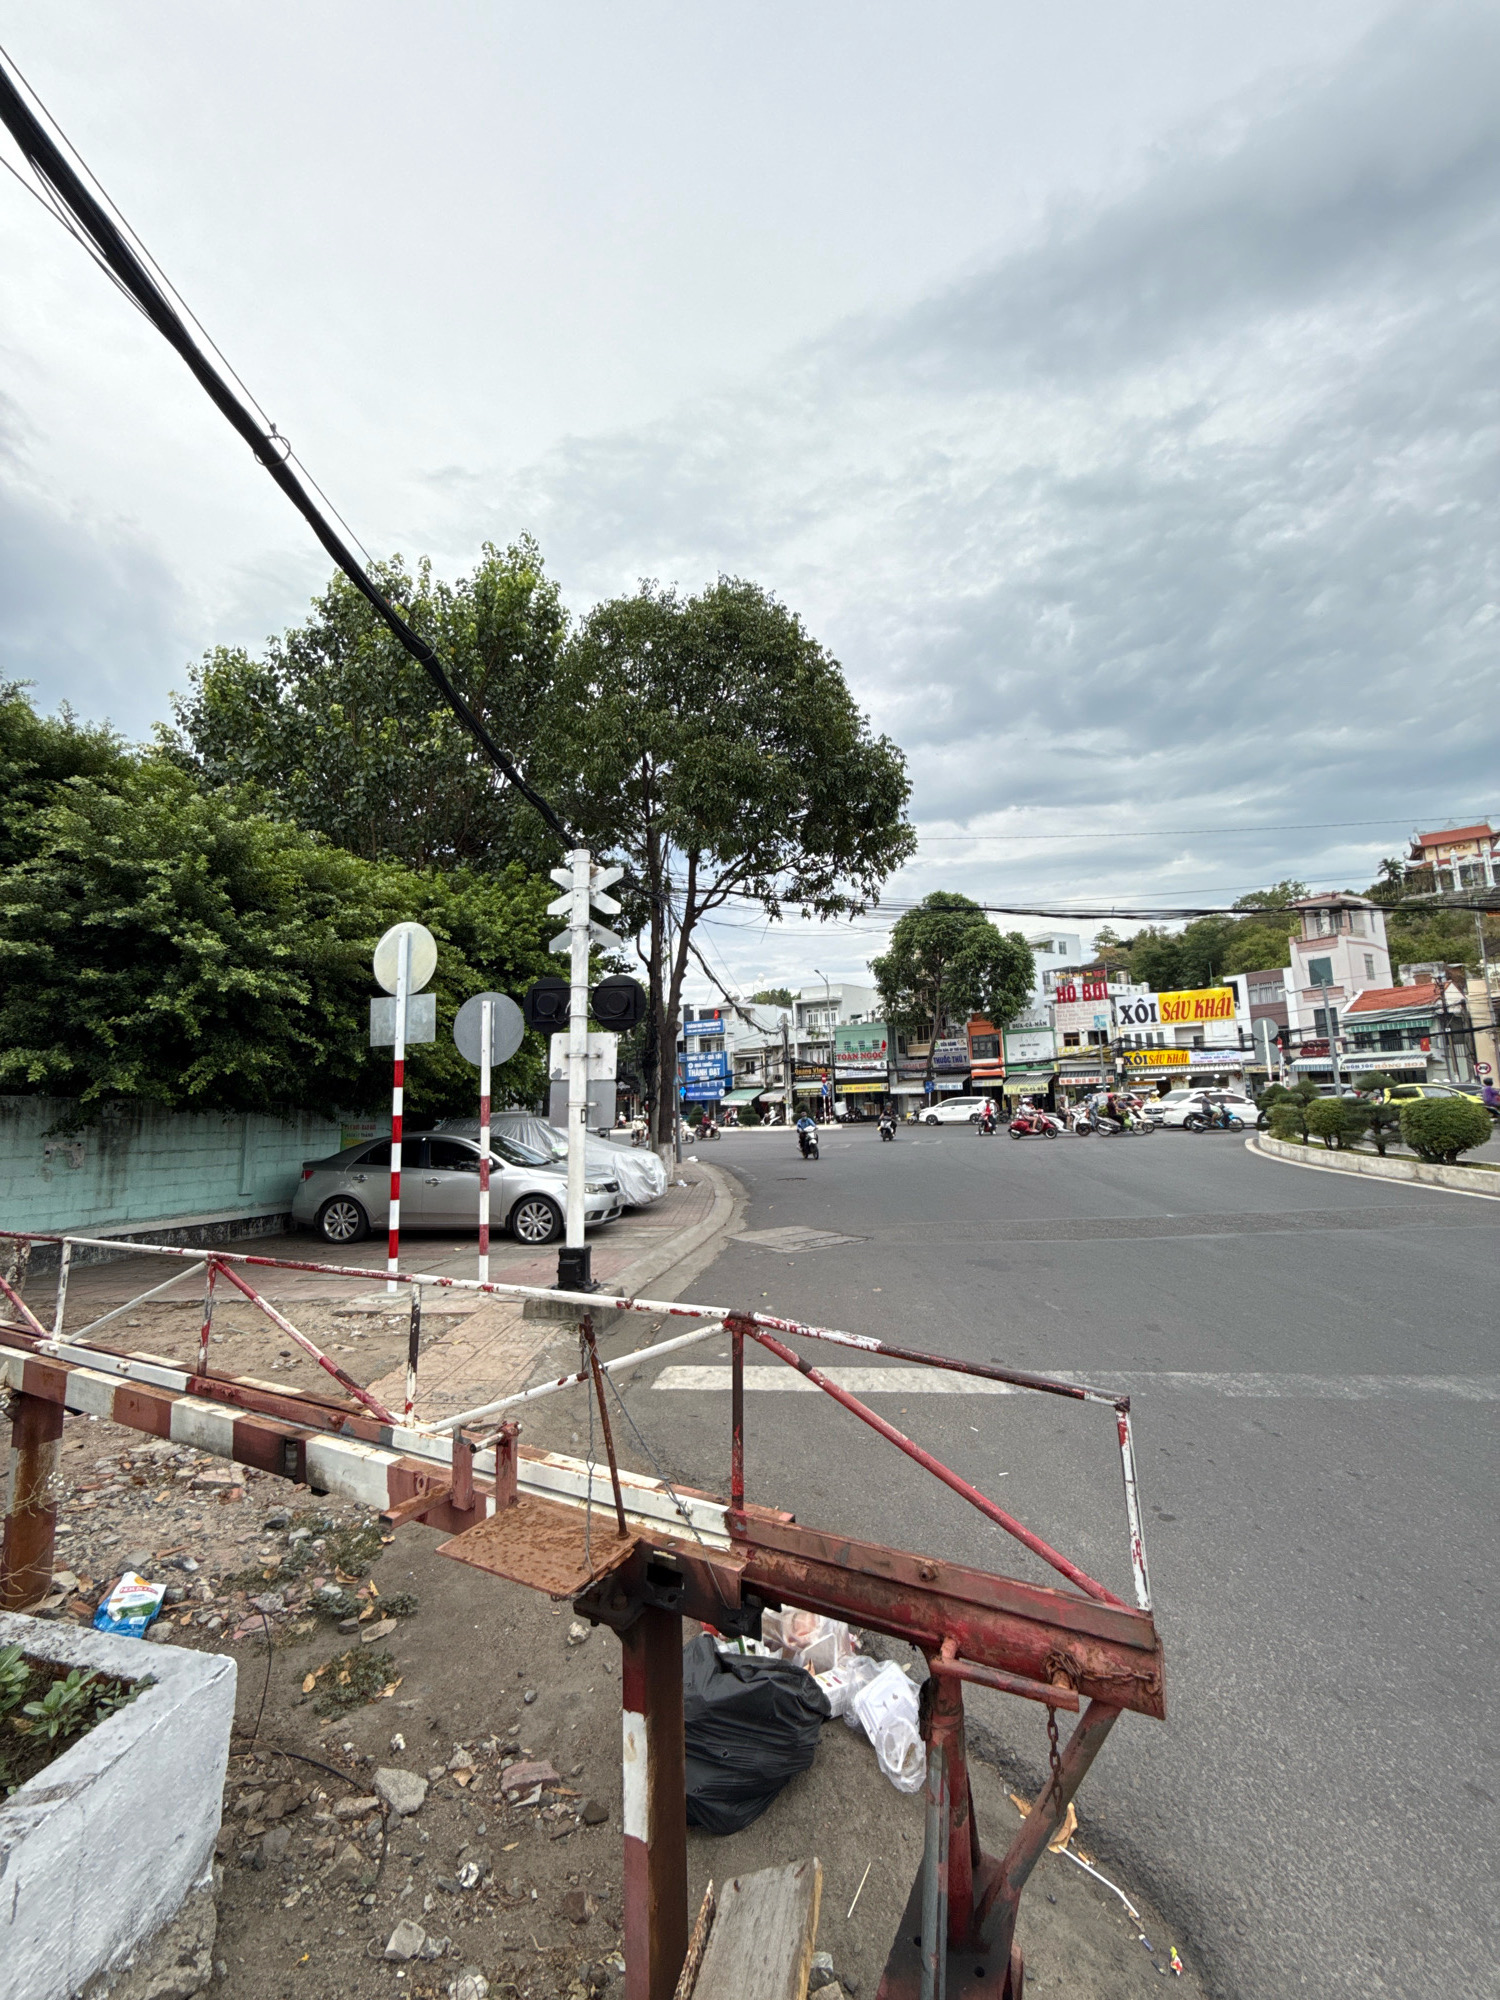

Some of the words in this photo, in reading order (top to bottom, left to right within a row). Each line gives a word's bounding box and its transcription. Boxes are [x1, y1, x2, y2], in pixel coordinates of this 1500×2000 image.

[1056, 980, 1077, 1004] HỒ
[1082, 980, 1108, 1001] BƠI
[1119, 998, 1158, 1025] XÔI
[1161, 996, 1191, 1021] SÁU
[1194, 992, 1232, 1019] KHẢI
[836, 1052, 858, 1061] TOÀN
[861, 1051, 884, 1060] NGỌC
[933, 1054, 952, 1065] THUỐC
[1124, 1050, 1148, 1066] XÔI
[1149, 1051, 1166, 1065] SÁU
[1167, 1050, 1188, 1064] KHẢI
[688, 1067, 707, 1077] THÀNH
[709, 1067, 720, 1077] ĐẠT
